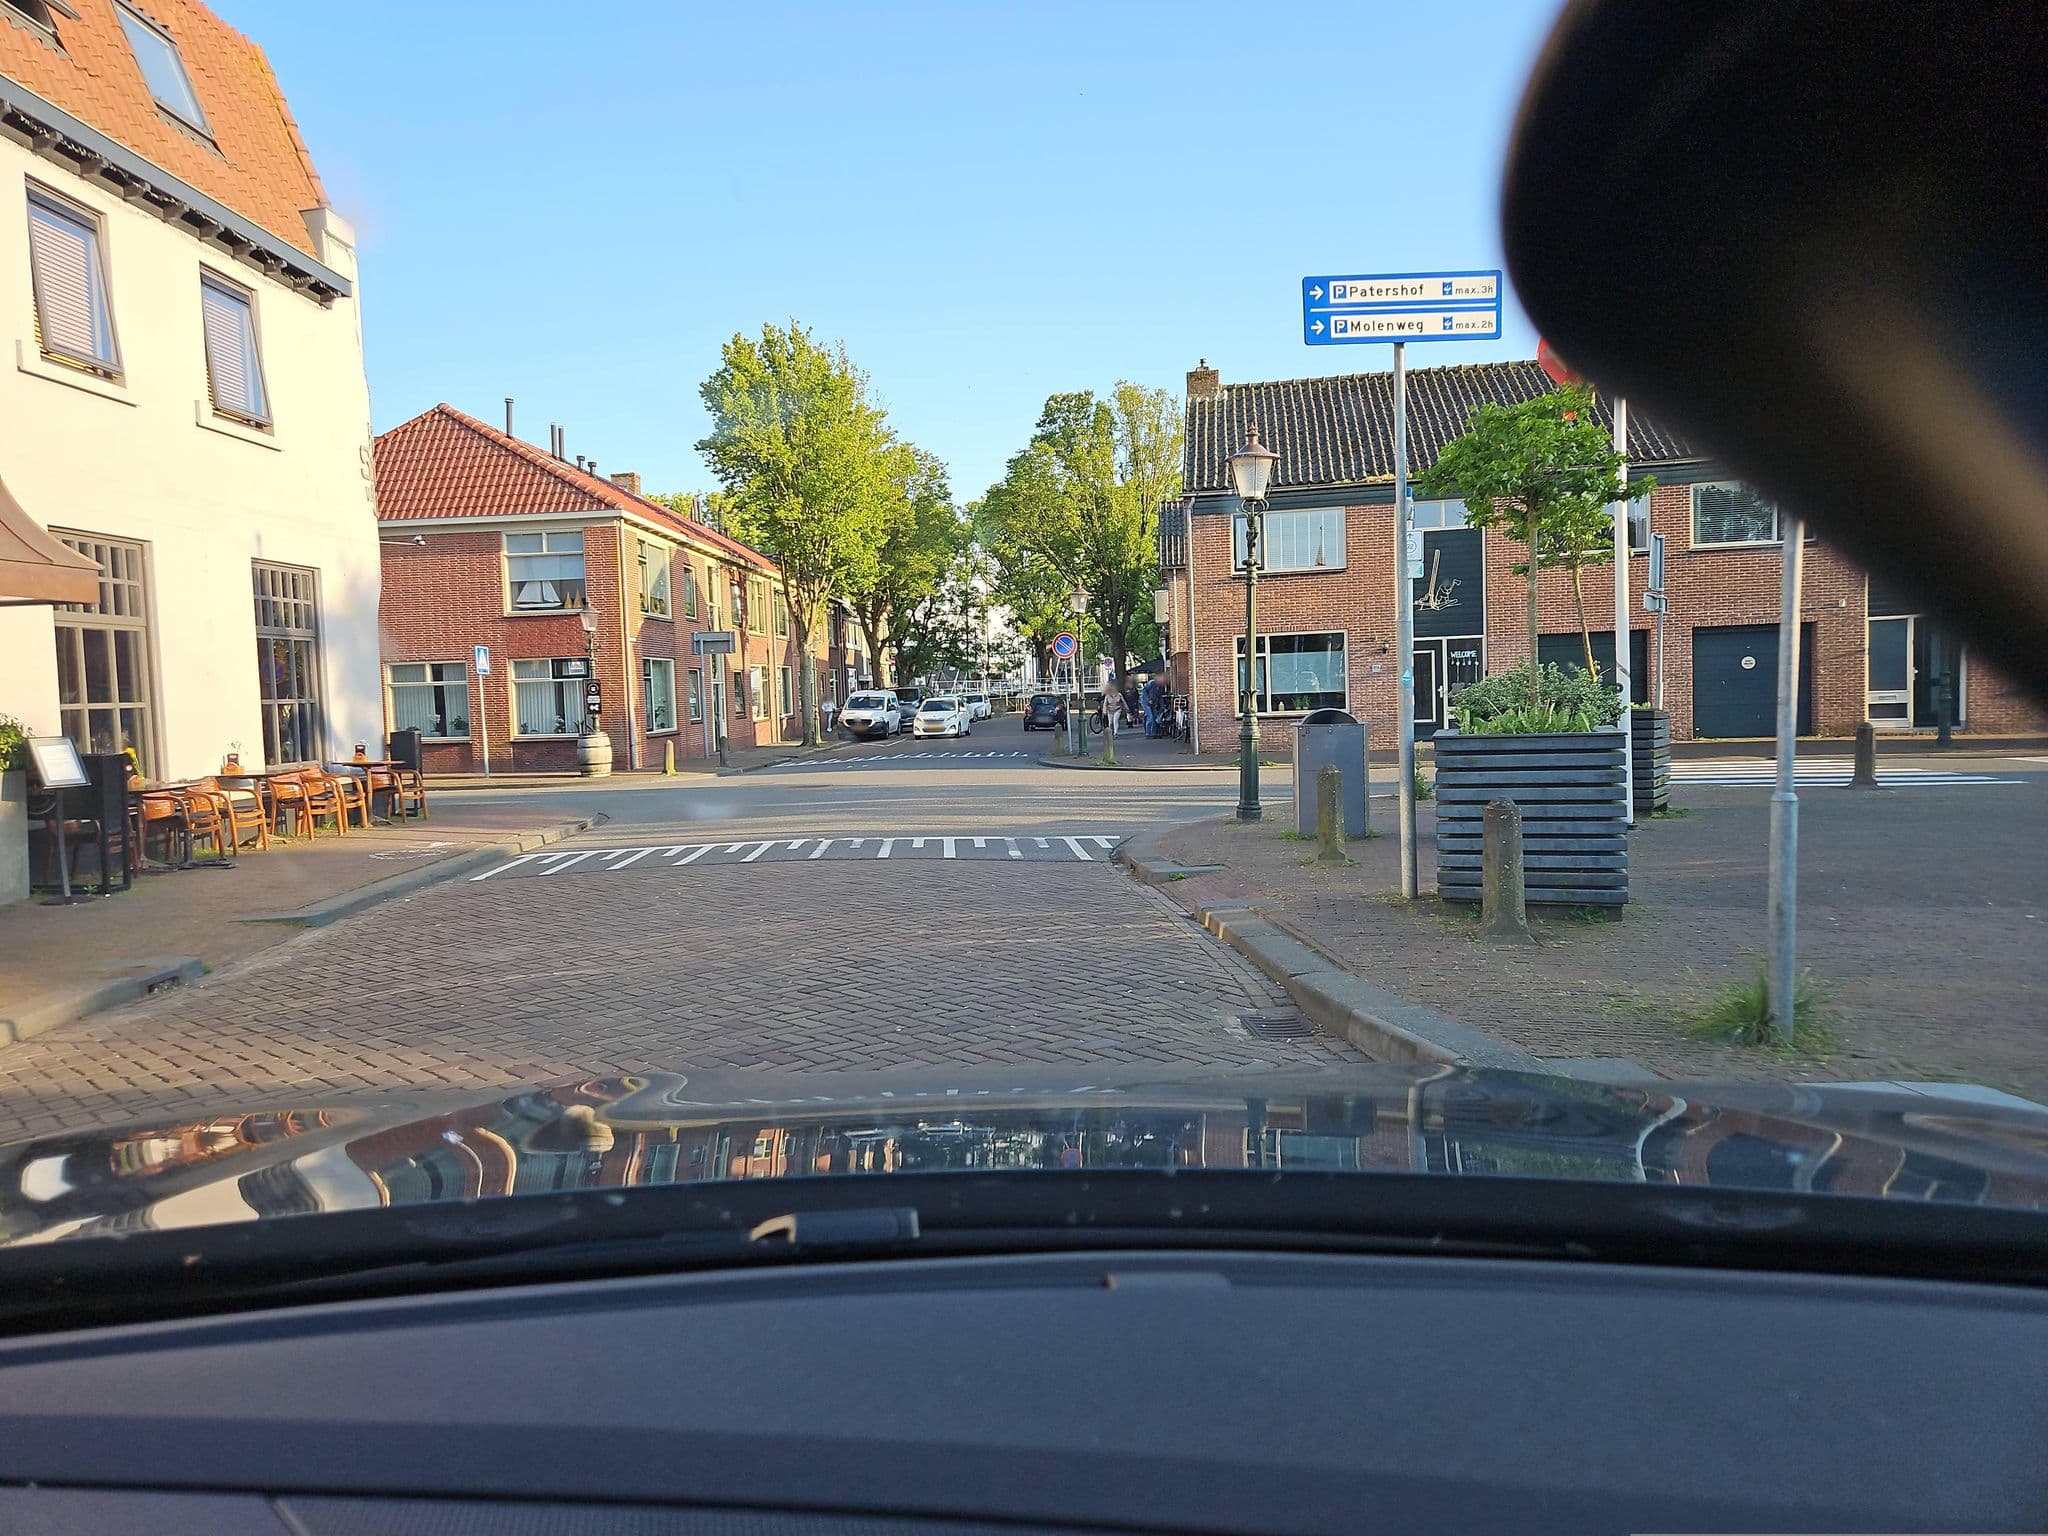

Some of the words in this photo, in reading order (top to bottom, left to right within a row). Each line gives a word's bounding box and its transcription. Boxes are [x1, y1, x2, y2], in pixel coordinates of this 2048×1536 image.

[1349, 283, 1424, 297] Patershof
[1350, 321, 1424, 333] Molenweg
[1450, 650, 1478, 658] WELCOME
